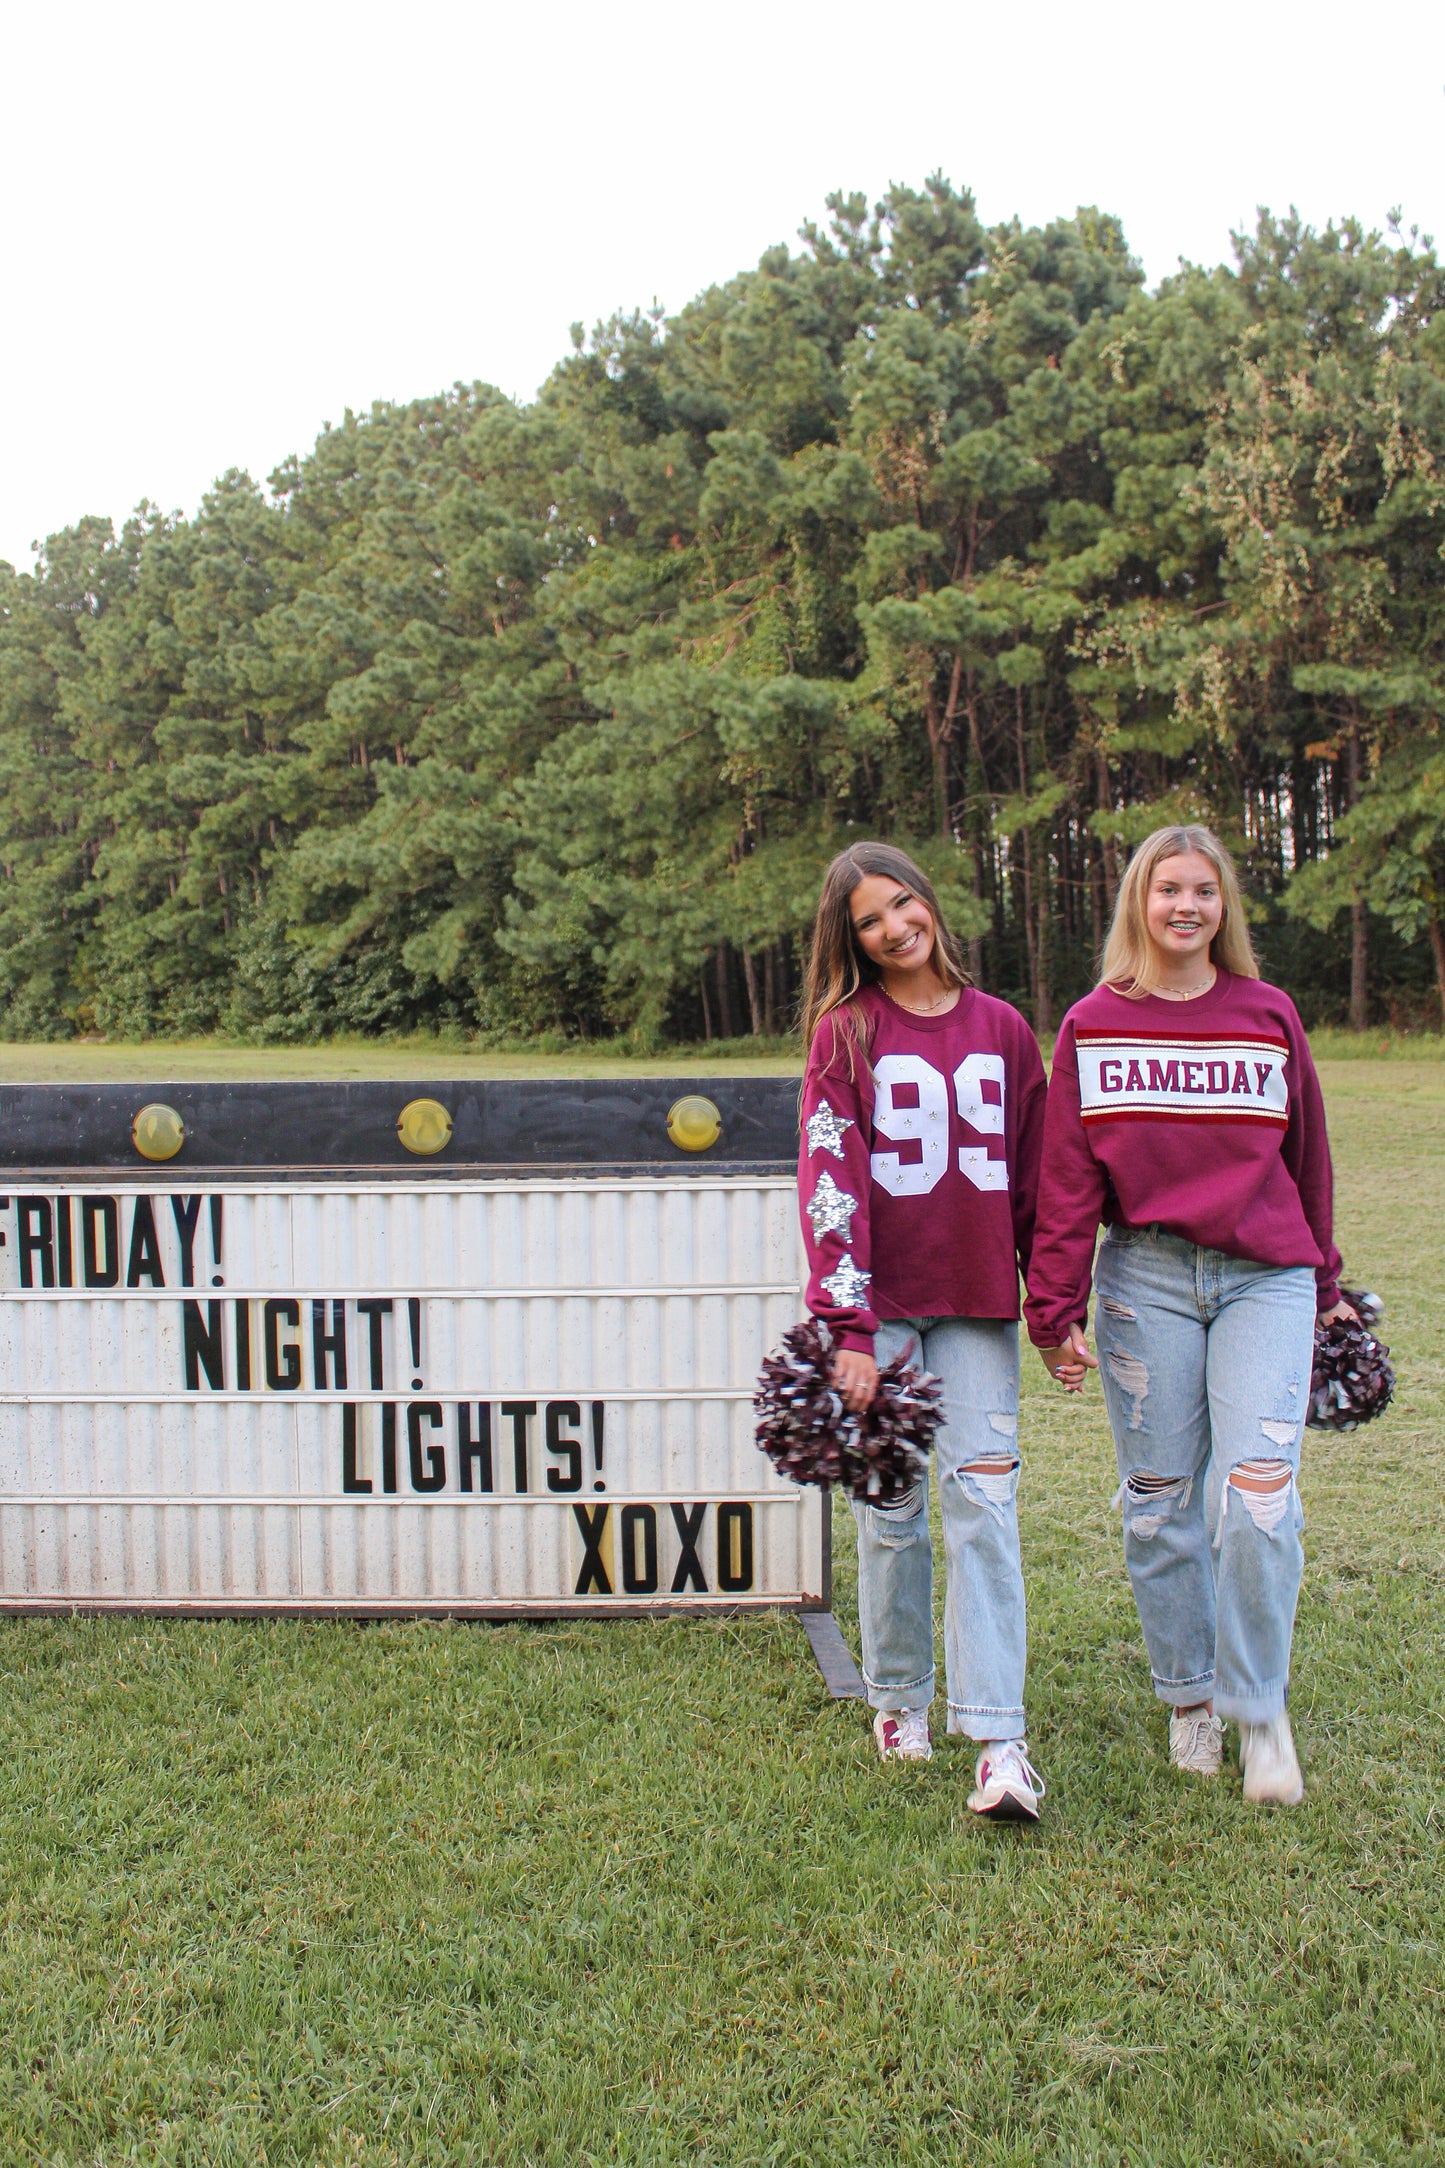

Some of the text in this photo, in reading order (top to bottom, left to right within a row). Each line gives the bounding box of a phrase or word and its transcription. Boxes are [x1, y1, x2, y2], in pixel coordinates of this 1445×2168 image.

[1099, 1059, 1272, 1097] GAMEDAY
[870, 1053, 1009, 1196] 99
[182, 1298, 424, 1390] NIGHT!
[343, 1401, 606, 1493] LIGHTS!
[572, 1502, 754, 1594] XOXO
